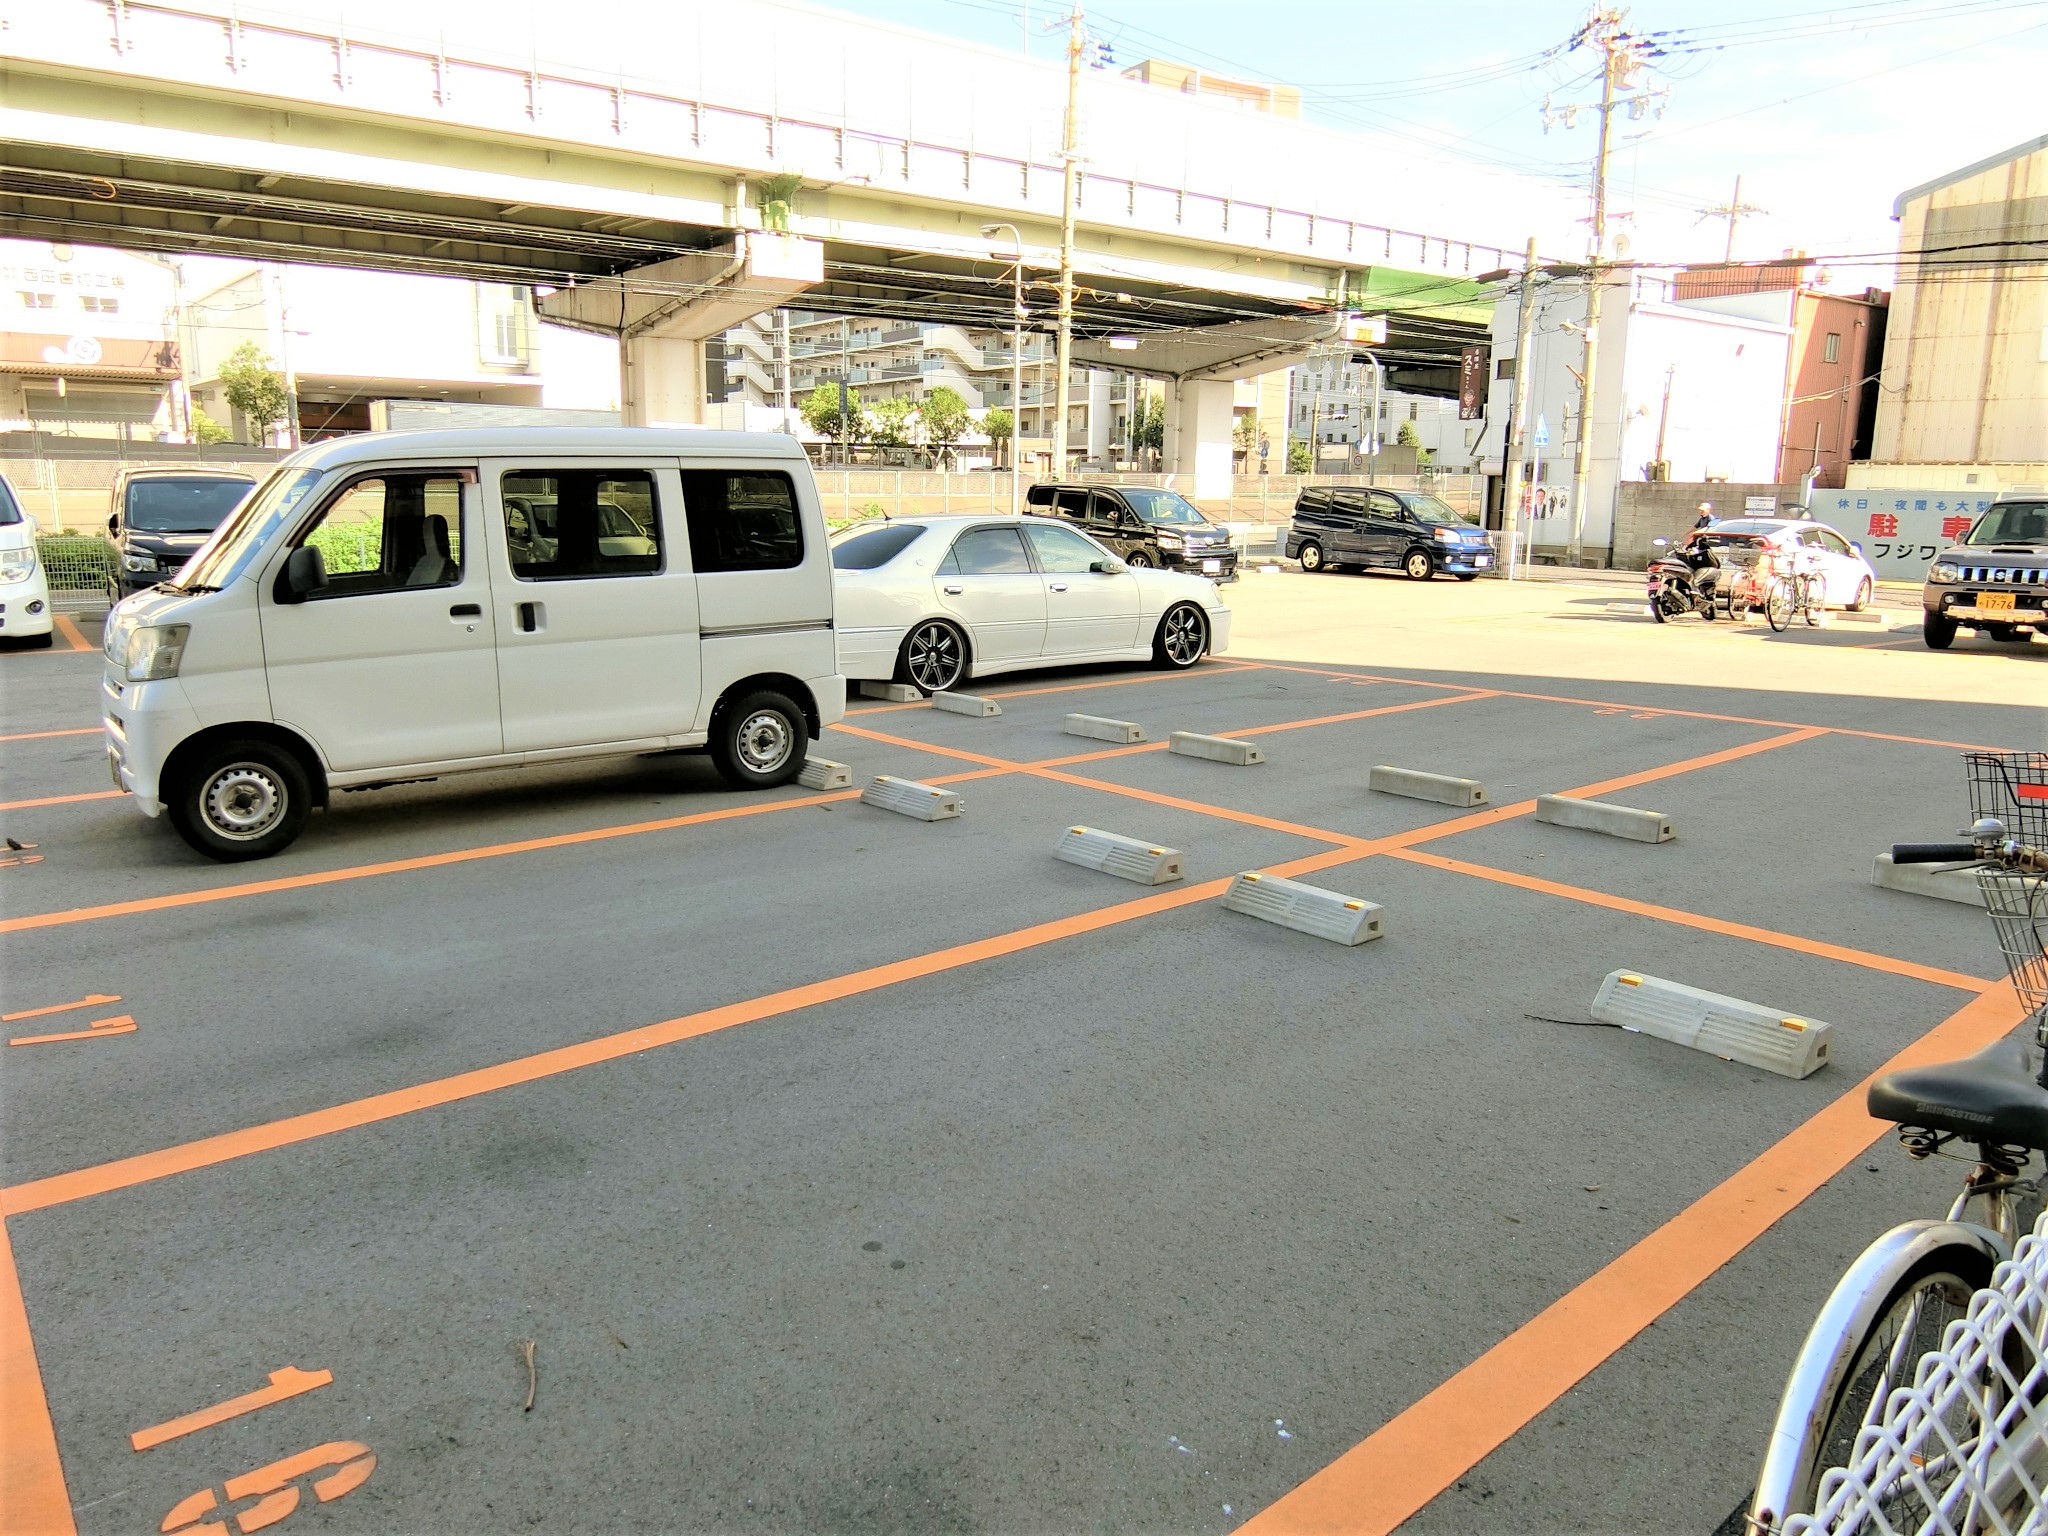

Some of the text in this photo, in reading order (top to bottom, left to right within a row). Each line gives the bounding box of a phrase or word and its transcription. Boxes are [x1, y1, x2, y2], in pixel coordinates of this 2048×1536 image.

[1873, 543, 1951, 561] フジワ
[1985, 599, 2013, 610] 17-76
